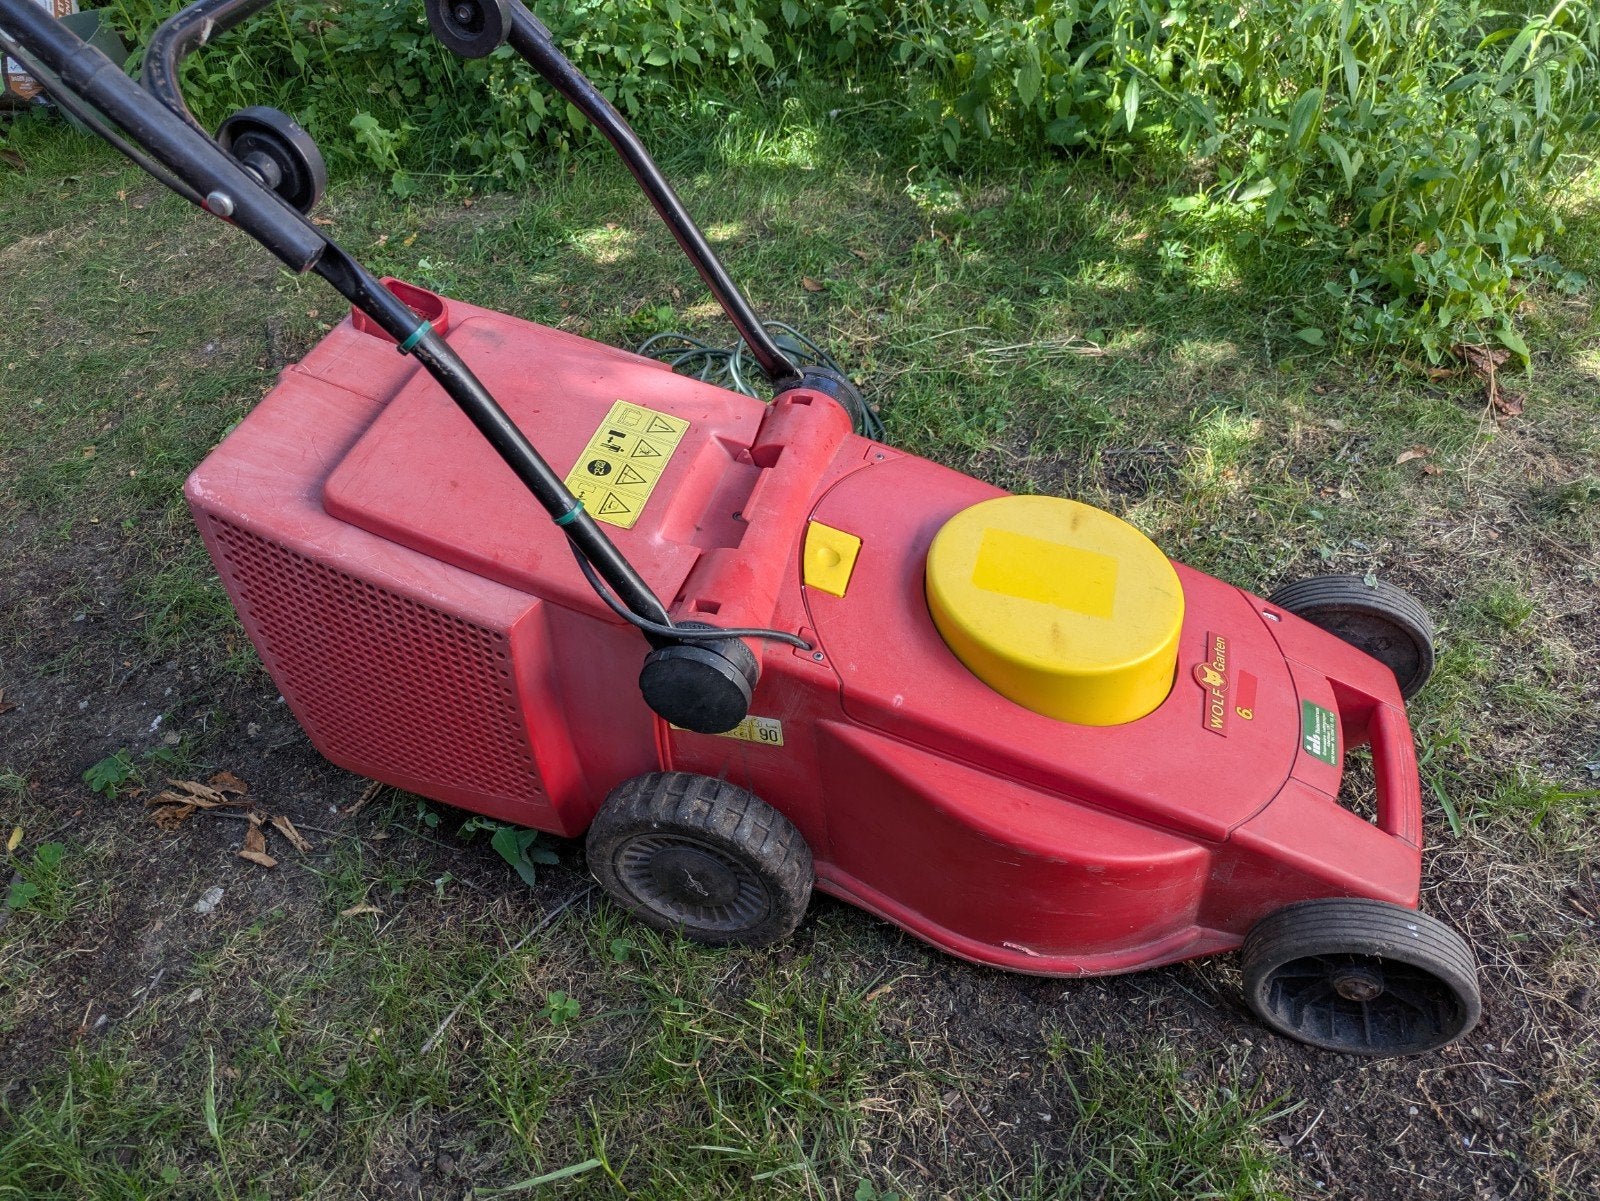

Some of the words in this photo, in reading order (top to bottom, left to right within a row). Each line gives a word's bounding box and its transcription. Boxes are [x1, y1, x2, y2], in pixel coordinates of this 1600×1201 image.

[1212, 636, 1226, 672] Garten
[1210, 688, 1224, 729] WOLF
[759, 728, 778, 742] 90
